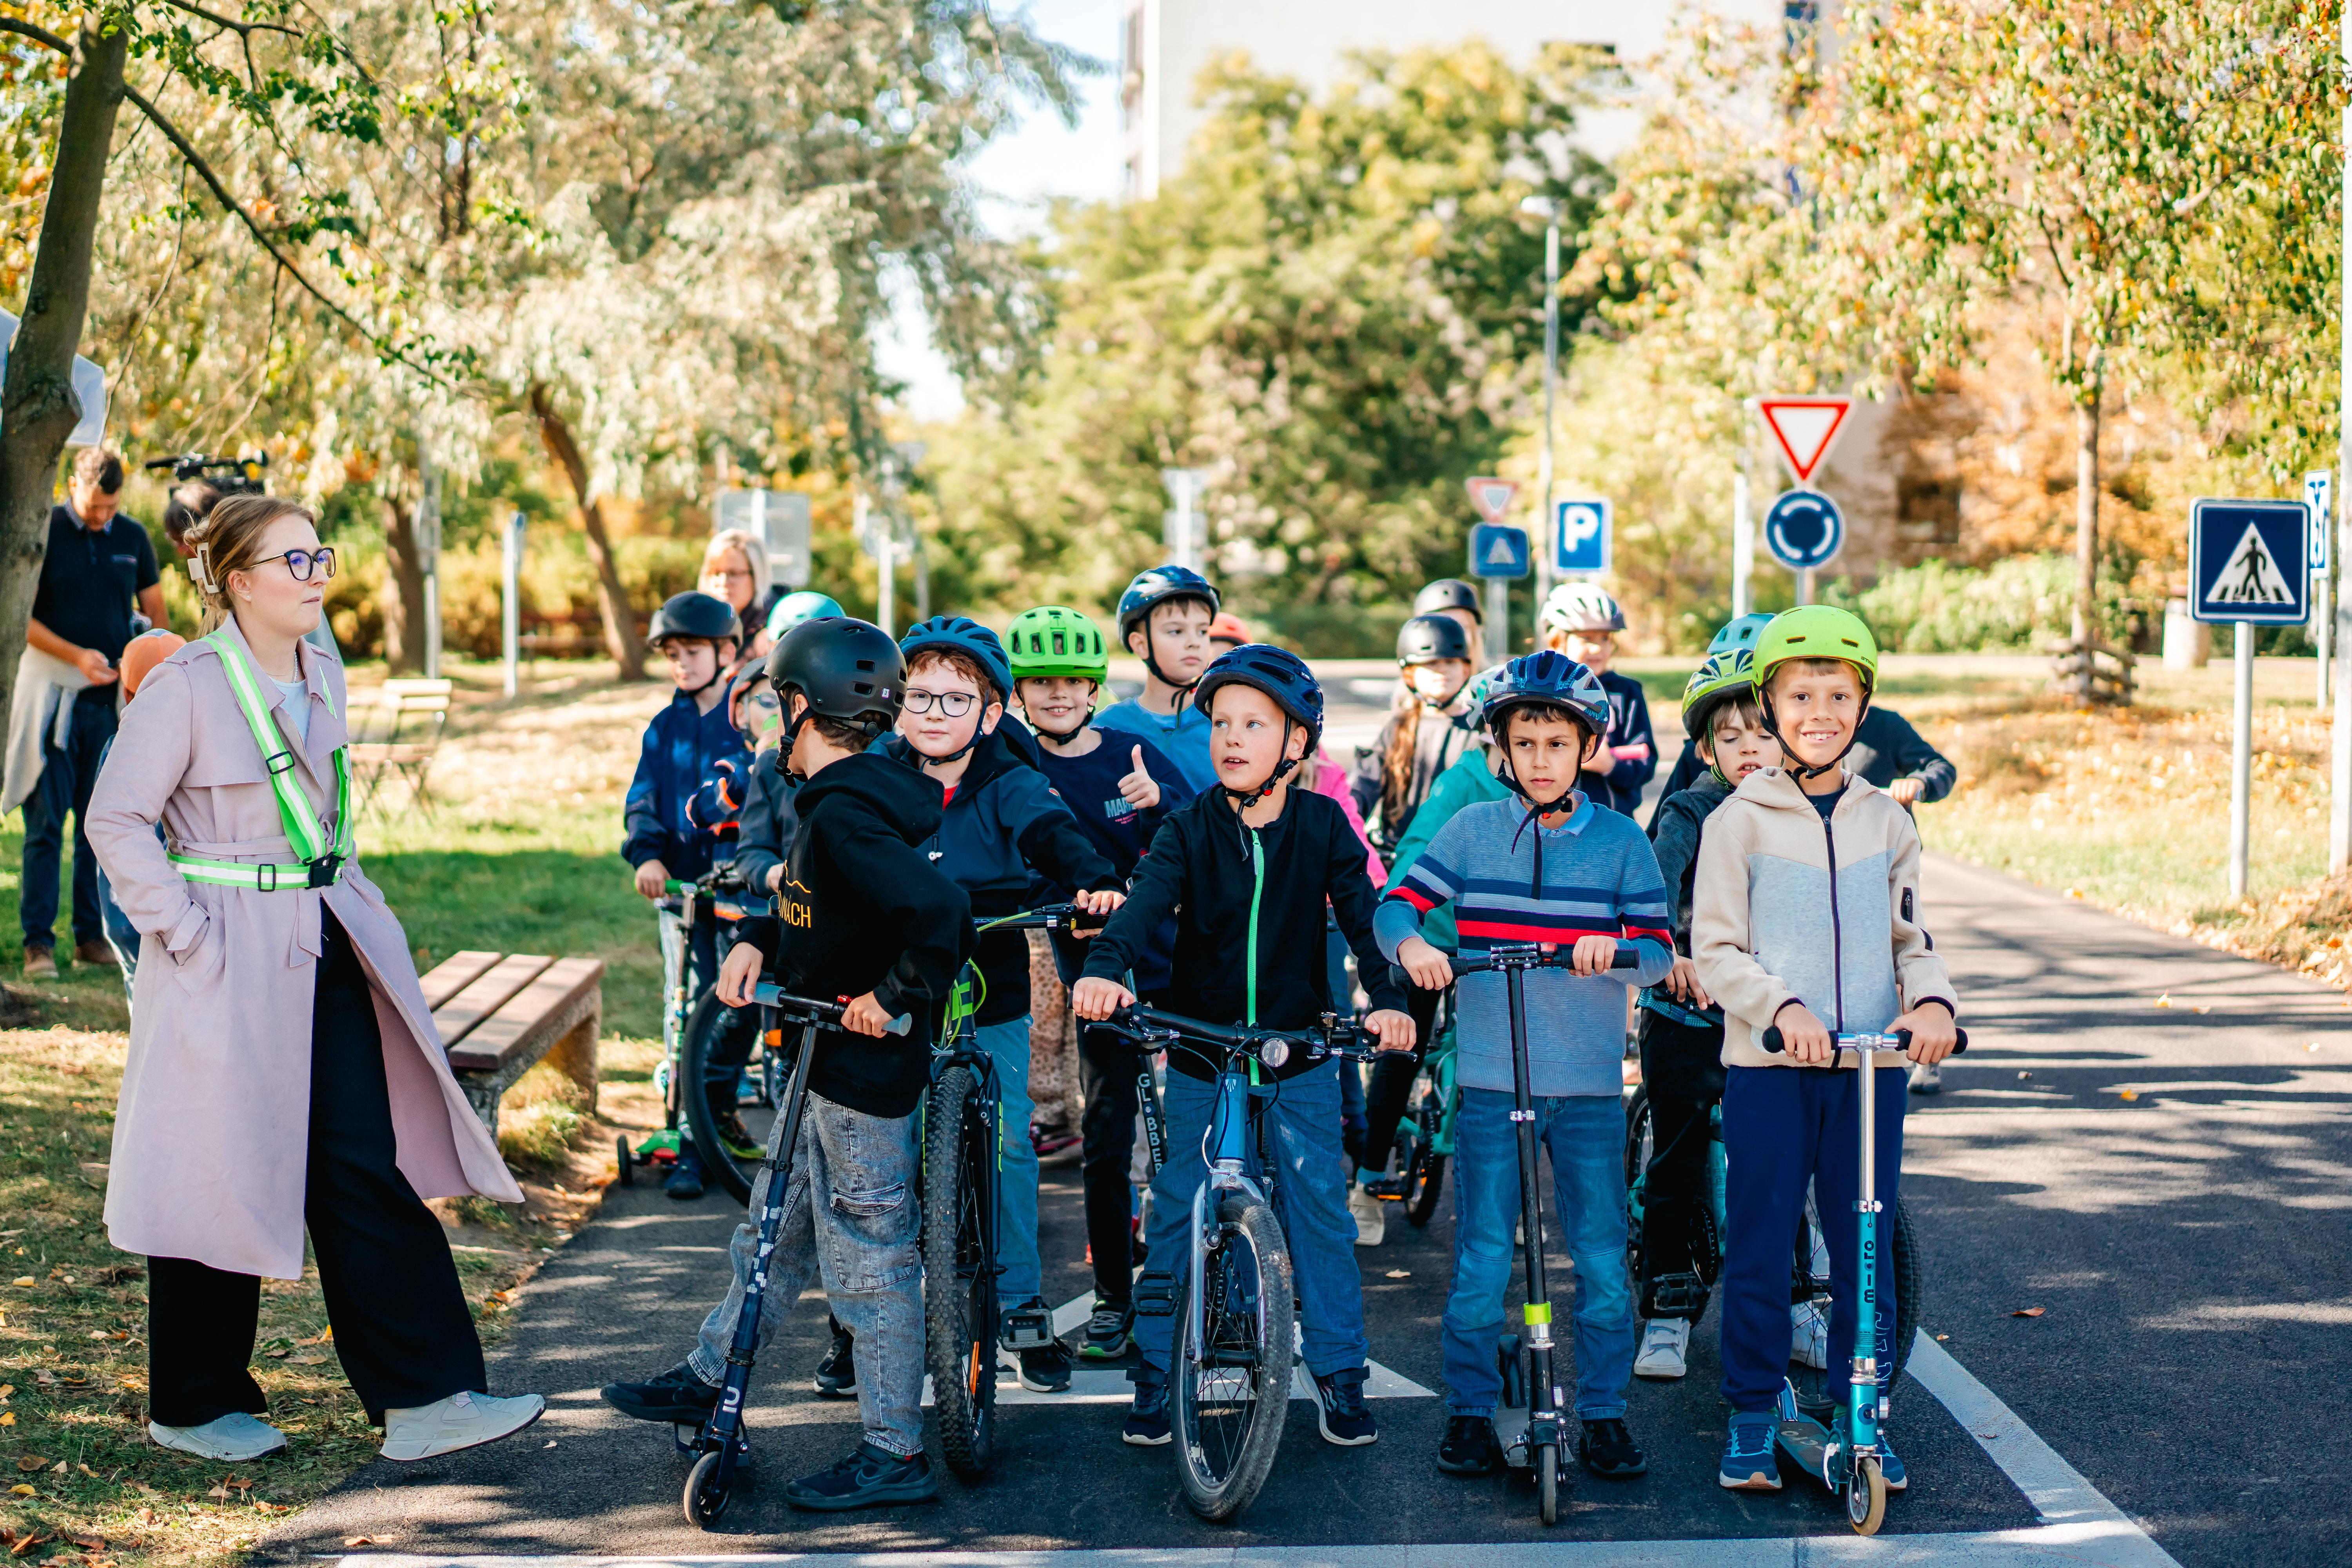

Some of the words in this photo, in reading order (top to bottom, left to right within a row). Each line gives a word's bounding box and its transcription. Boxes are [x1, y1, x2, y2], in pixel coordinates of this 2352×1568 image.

[1564, 504, 1599, 553] P
[1104, 797, 1136, 818] MAR
[1864, 1240, 1874, 1303] micro
